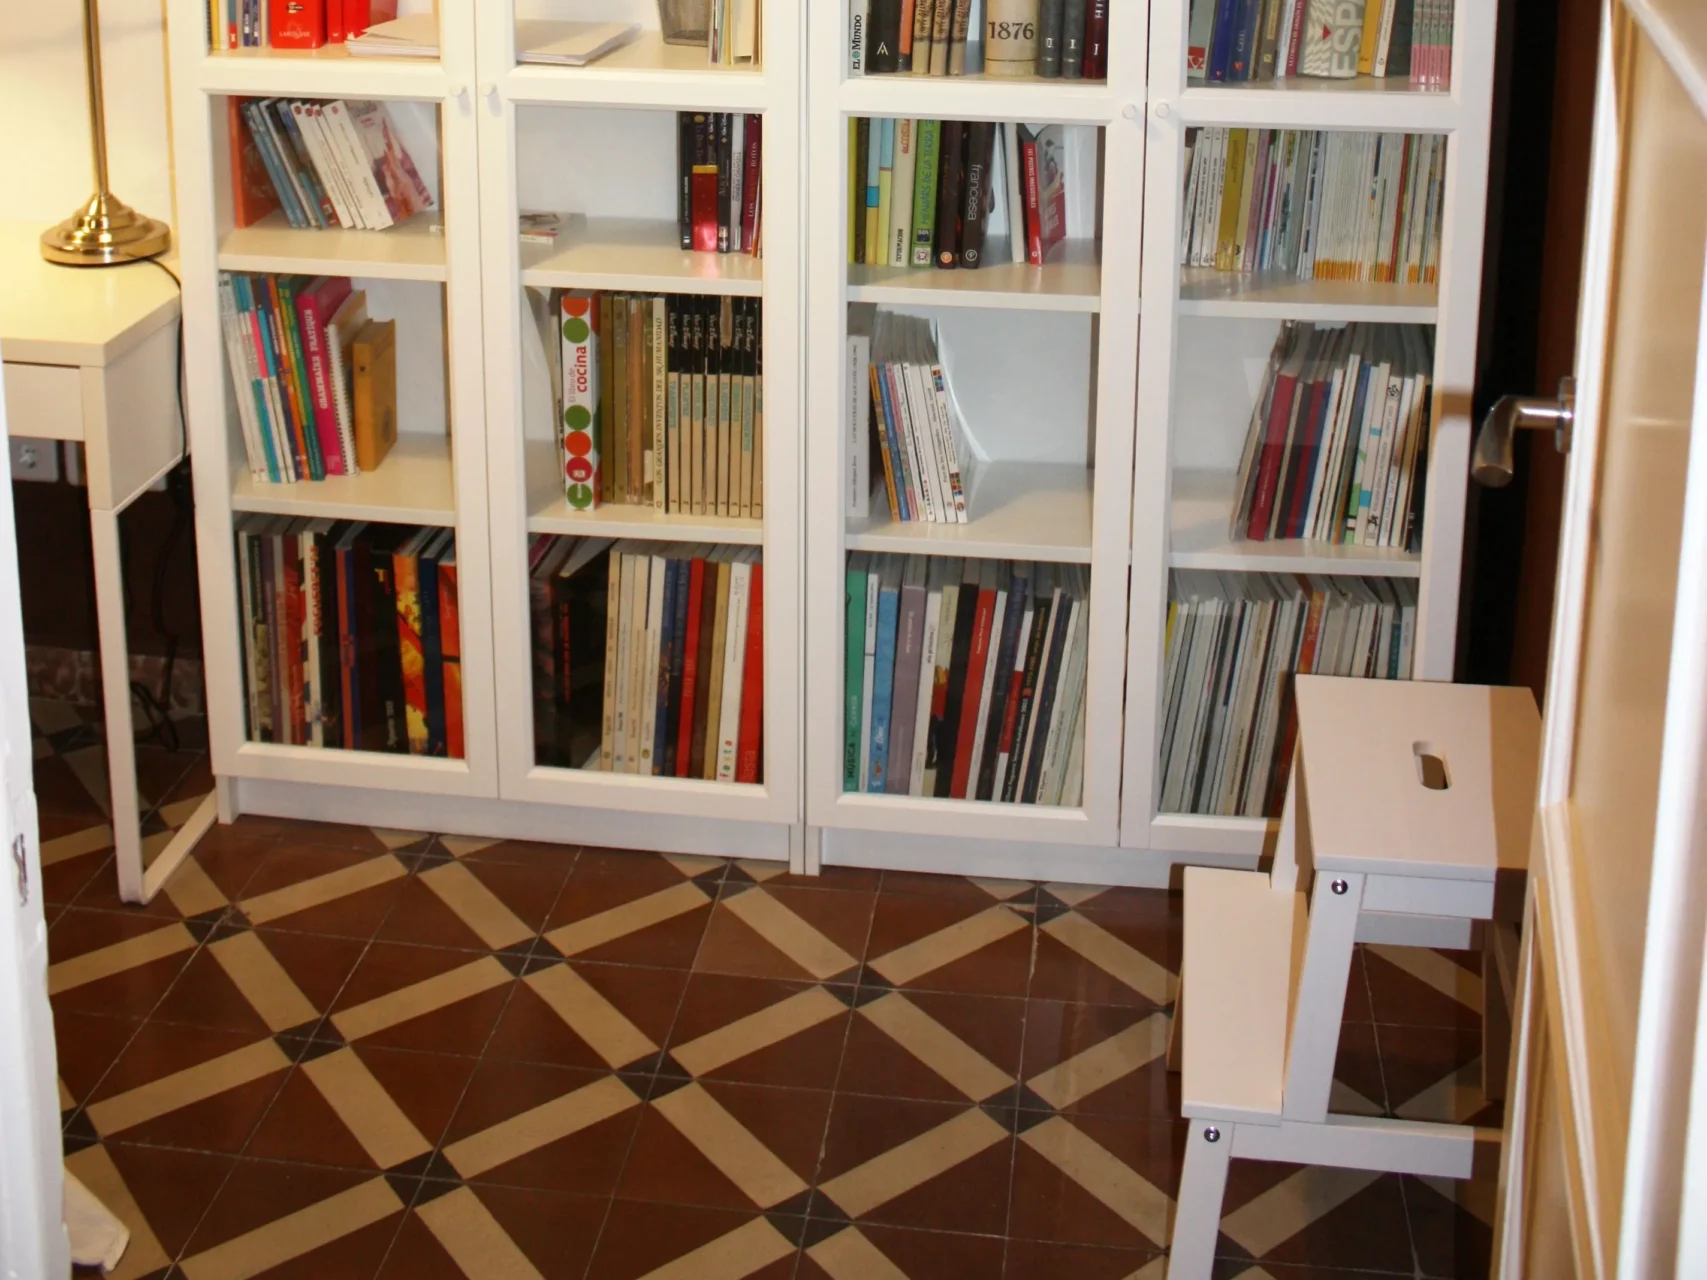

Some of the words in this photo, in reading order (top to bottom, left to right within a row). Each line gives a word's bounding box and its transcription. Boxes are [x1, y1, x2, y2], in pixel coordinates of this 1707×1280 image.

[851, 14, 862, 51] MUNDO
[989, 22, 1035, 41] 1876
[852, 58, 861, 70] EL
[967, 164, 983, 221] francesa
[303, 309, 318, 352] PRATIQUE
[311, 356, 328, 409] GRAMMAIRE
[568, 378, 576, 395] libro
[574, 346, 588, 393] cocina
[846, 742, 857, 779] MÚSICA
